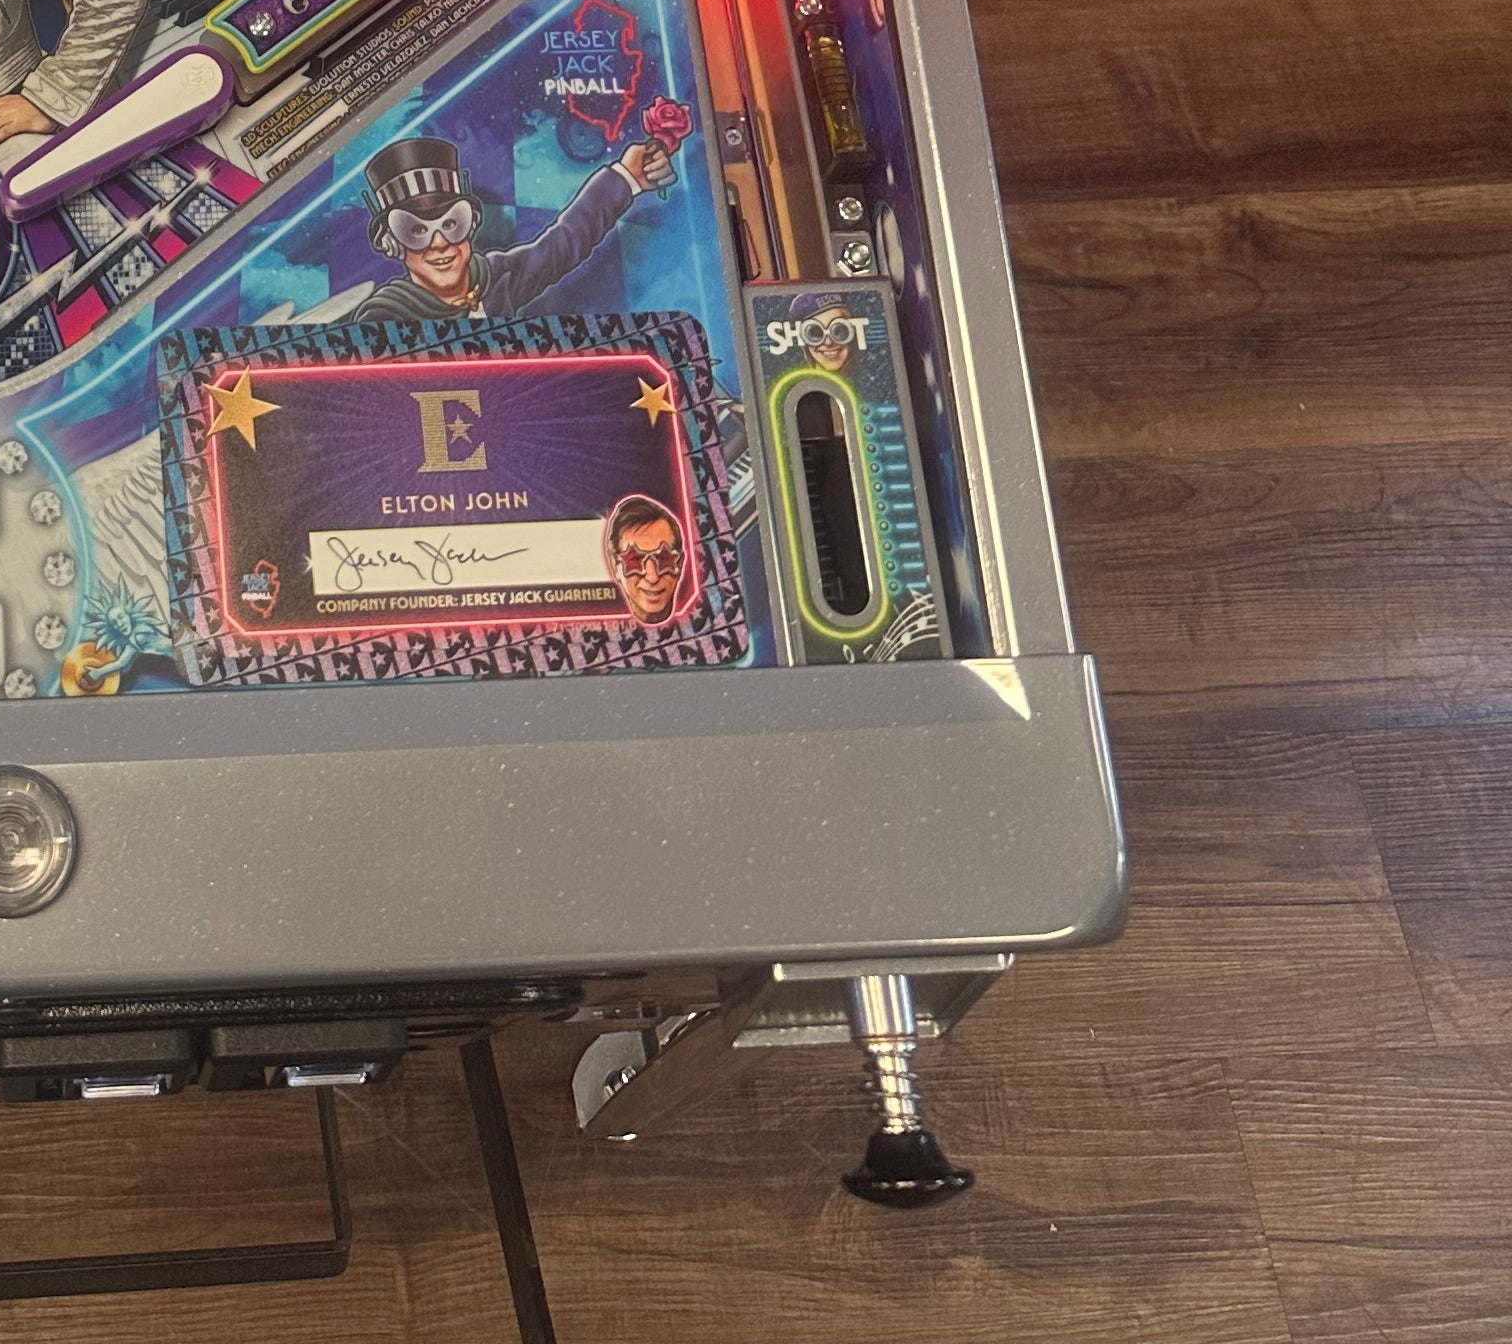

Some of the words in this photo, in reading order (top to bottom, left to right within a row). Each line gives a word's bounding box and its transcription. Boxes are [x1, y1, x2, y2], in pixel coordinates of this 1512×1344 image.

[354, 48, 389, 77] MOLTER
[389, 28, 416, 51] CHRIS
[541, 29, 618, 53] JERSEY
[309, 55, 357, 95] EVOLUTION
[357, 27, 393, 59] STUDIOS
[343, 72, 381, 105] ERNESTO
[380, 36, 429, 76] VELAZQUEZ
[554, 54, 615, 78] JACK
[544, 75, 626, 95] PINBALL
[381, 494, 455, 515] ELTON
[465, 491, 530, 512] JOHN
[316, 598, 387, 614] COMPANY
[389, 594, 459, 611] FOUNDER:
[460, 591, 506, 608] JERSEY
[508, 590, 542, 606] JACK
[544, 587, 617, 604] GUARNIERI
